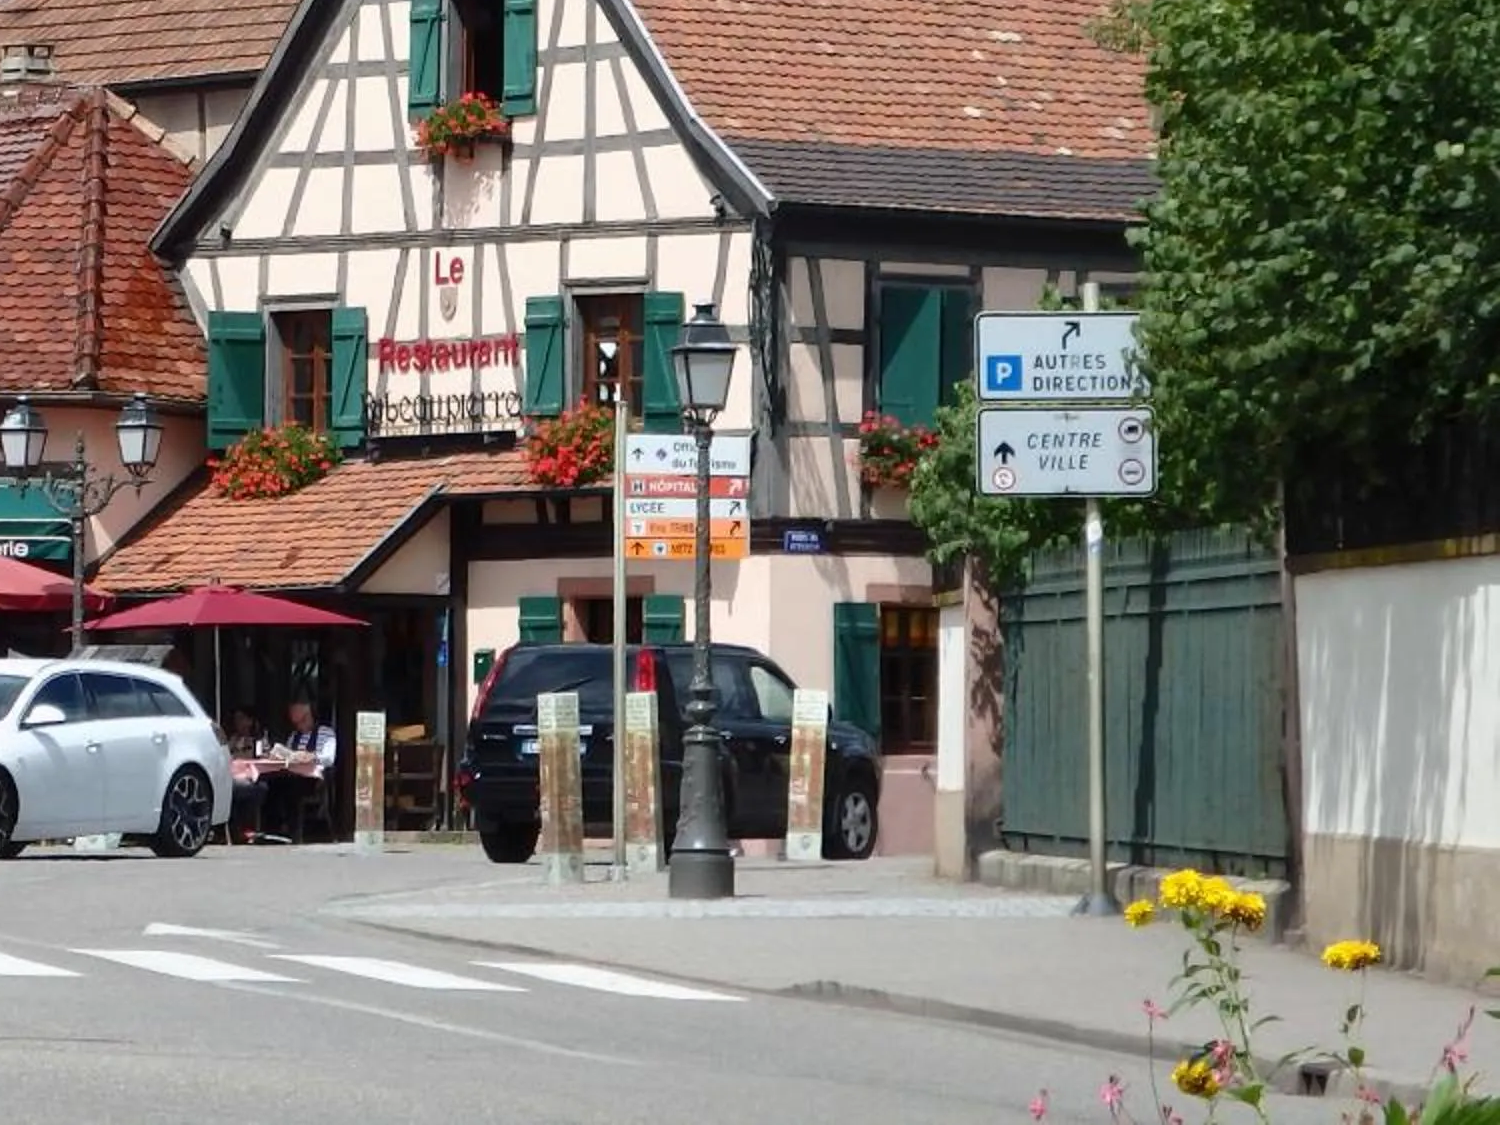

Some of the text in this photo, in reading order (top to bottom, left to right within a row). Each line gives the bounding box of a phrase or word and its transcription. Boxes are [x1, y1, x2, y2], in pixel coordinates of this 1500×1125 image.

[435, 251, 464, 285] Le
[378, 332, 519, 374] Restaurant
[1033, 354, 1107, 370] AUTRES
[996, 362, 1013, 384] P
[1027, 432, 1103, 450] CENTRE
[1038, 454, 1090, 471] VILLE
